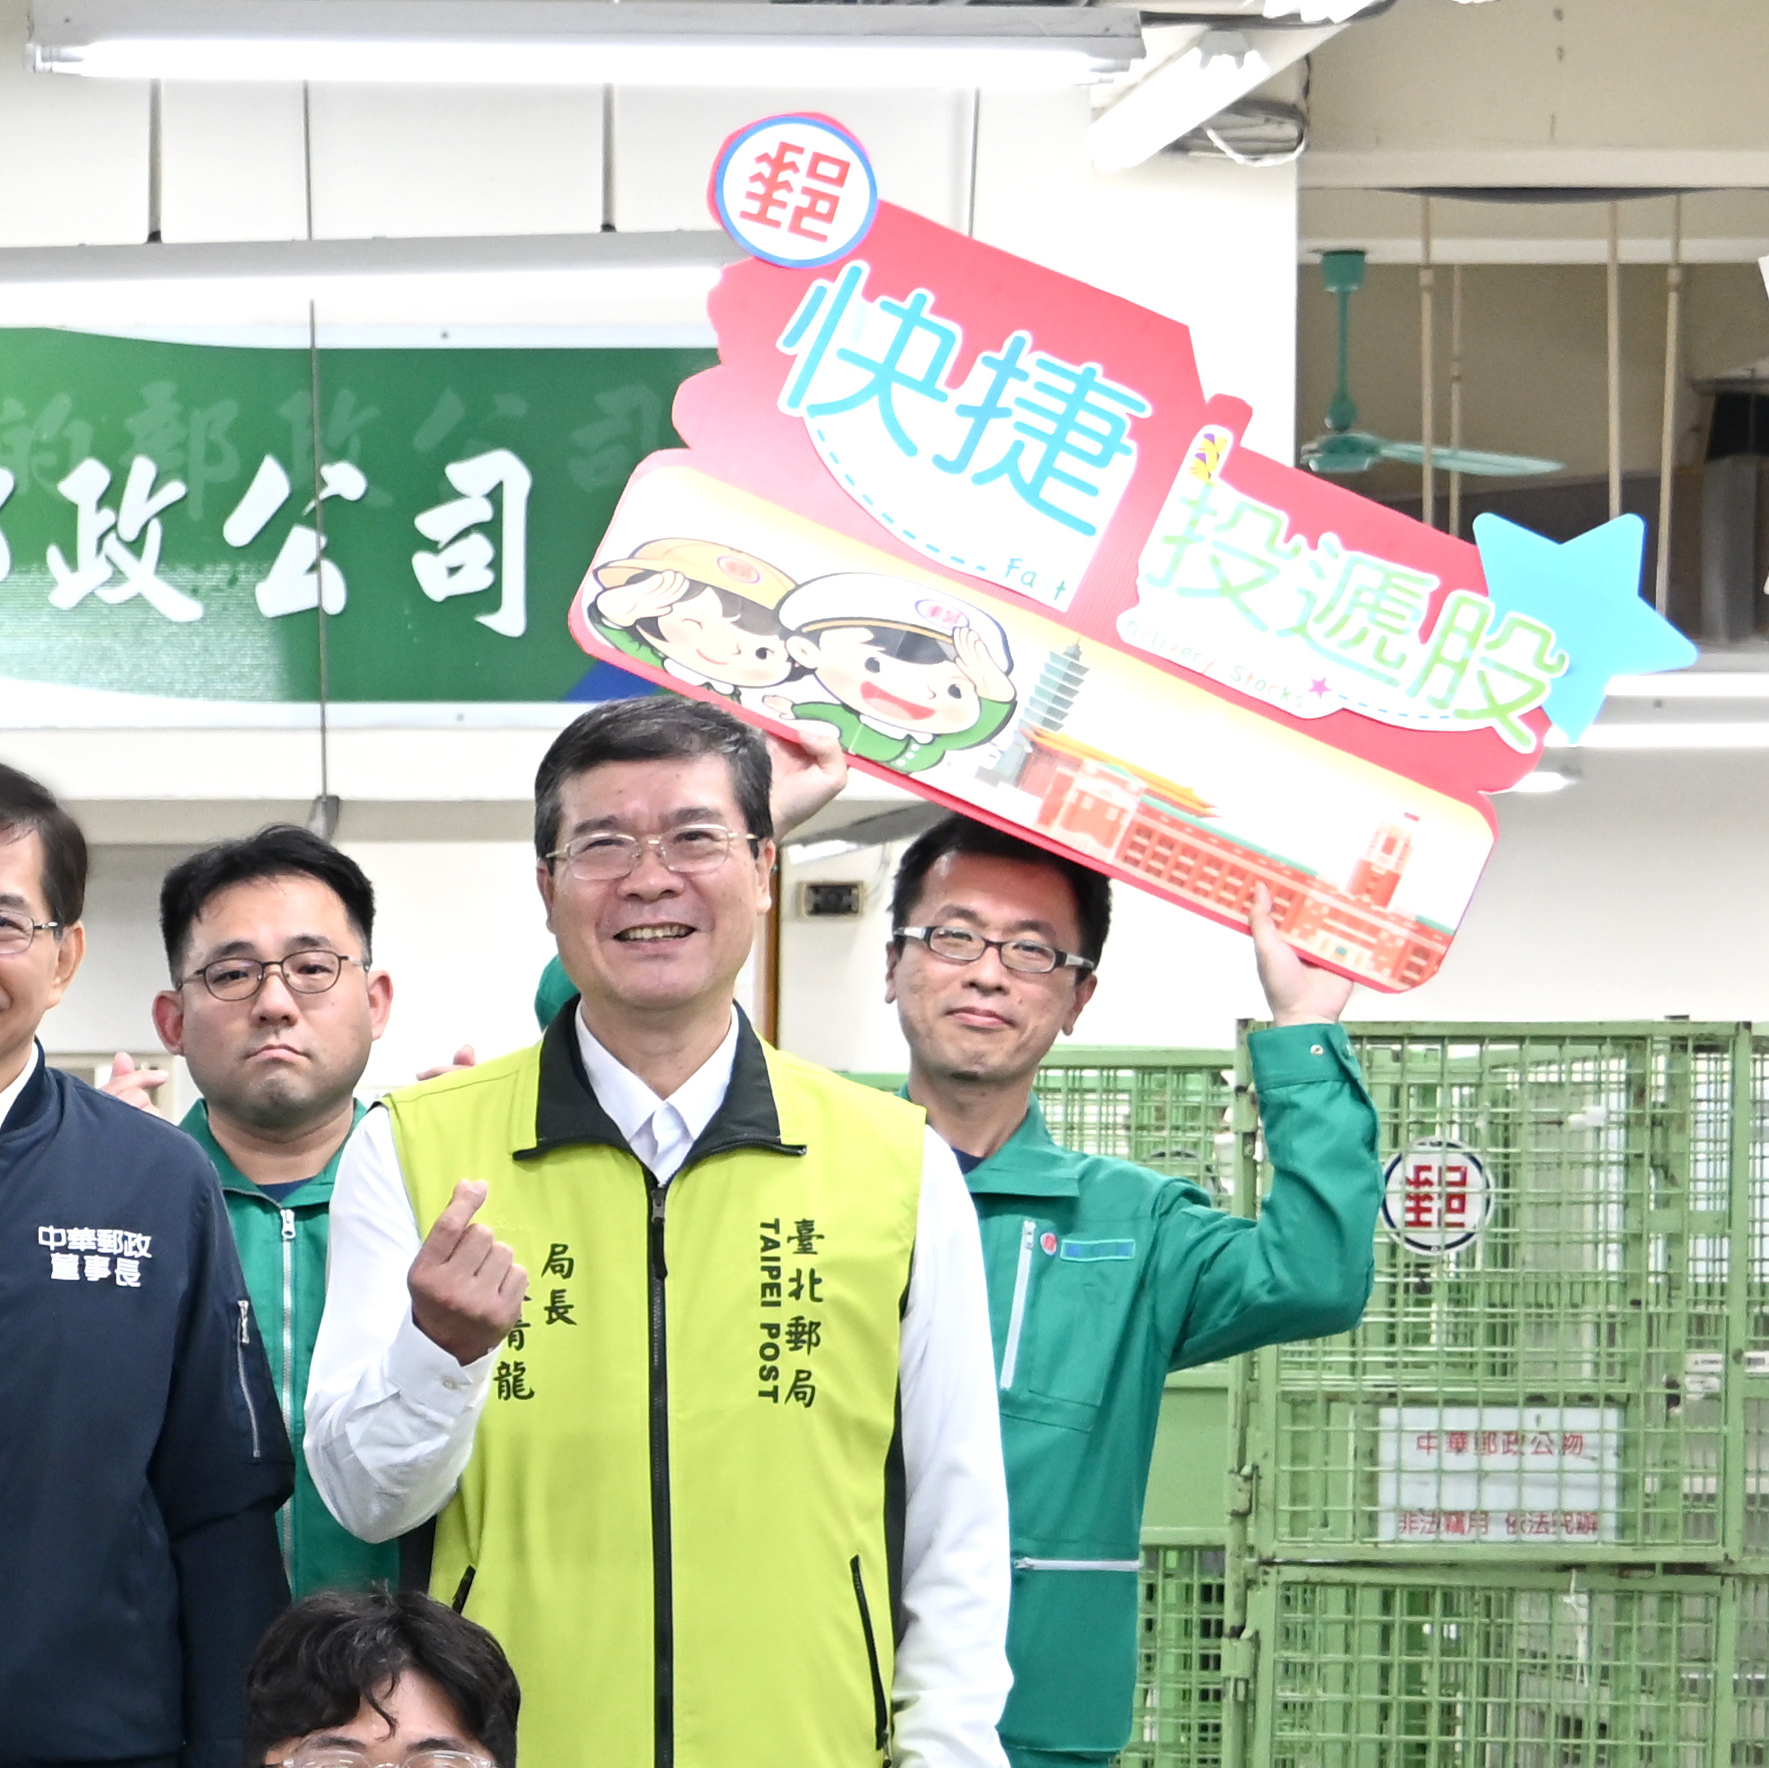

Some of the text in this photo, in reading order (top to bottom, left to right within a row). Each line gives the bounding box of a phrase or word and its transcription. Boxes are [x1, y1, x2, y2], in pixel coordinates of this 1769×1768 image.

[740, 139, 850, 244] 郵
[776, 262, 1149, 539] 快捷
[1143, 477, 1569, 747] 投遞股
[37, 1225, 152, 1258] 中華郵政
[50, 1252, 142, 1288] 董事長
[541, 1243, 578, 1326] 局長
[758, 1218, 782, 1403] TAIPEI POST
[784, 1218, 825, 1409] 臺北郵局
